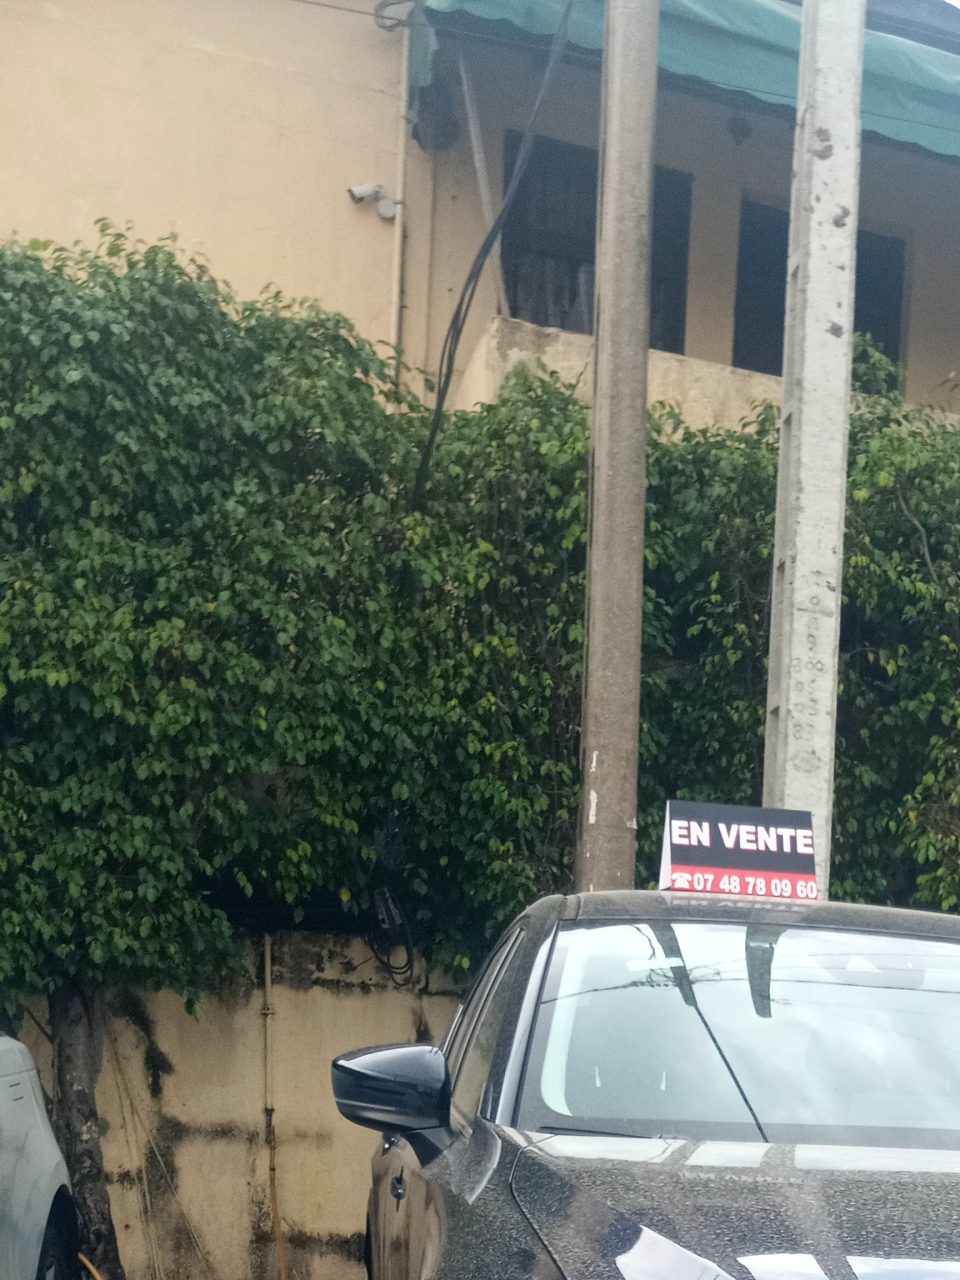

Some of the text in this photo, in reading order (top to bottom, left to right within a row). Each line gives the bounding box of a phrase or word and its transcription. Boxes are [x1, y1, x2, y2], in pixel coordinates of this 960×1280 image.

[671, 819, 815, 855] EN VENTE
[693, 872, 817, 899] 07 48 78 09 60
